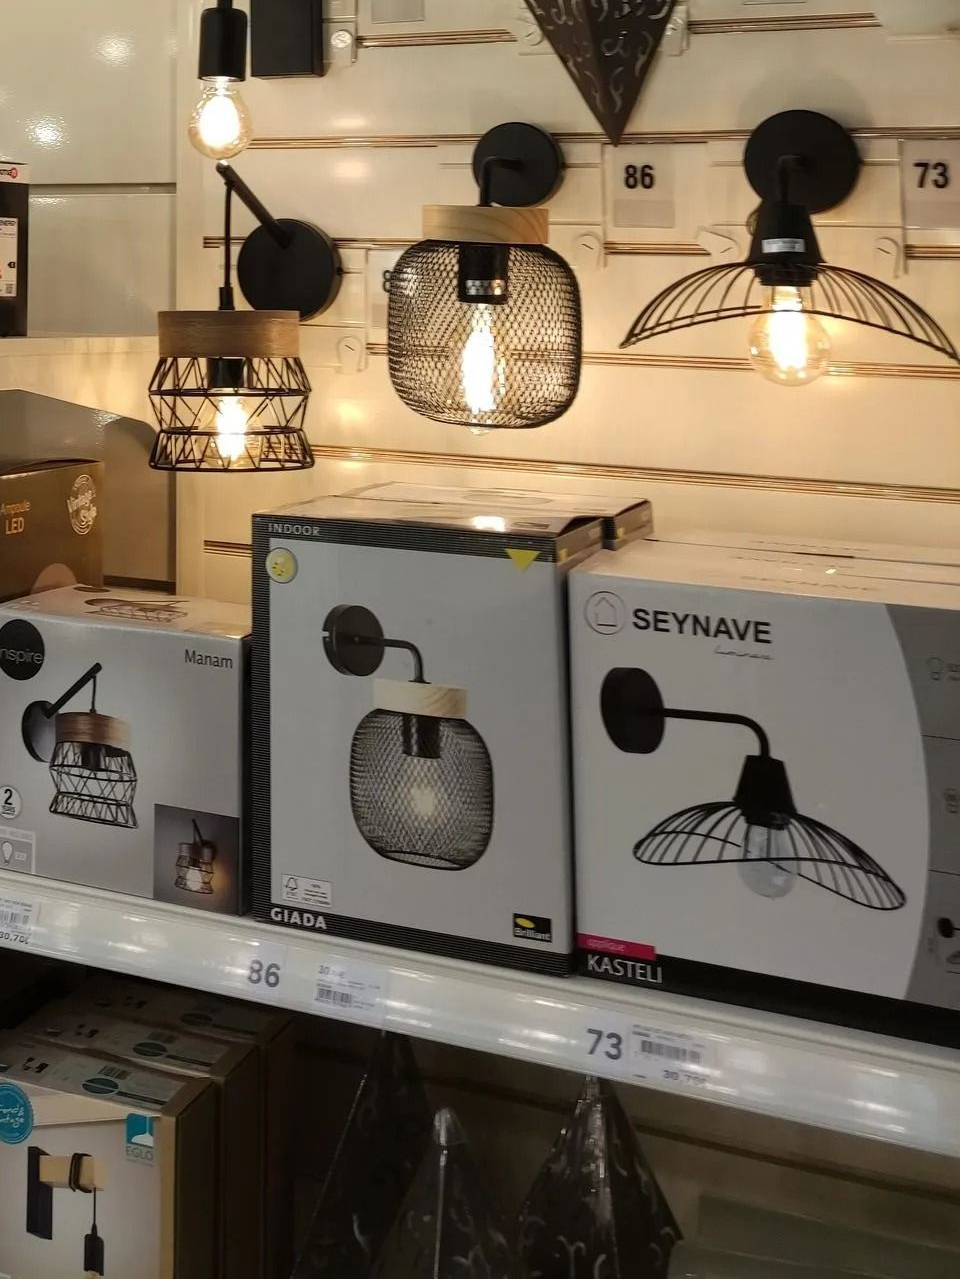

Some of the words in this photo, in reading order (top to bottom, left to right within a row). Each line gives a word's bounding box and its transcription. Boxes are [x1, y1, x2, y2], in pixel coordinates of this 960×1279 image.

[624, 164, 656, 190] 86
[914, 162, 949, 189] 73
[0, 500, 31, 516] Ampoule
[5, 517, 25, 535] LED
[267, 523, 321, 537] INDOOR
[632, 608, 773, 644] SEYNAVE
[184, 649, 234, 669] Manam
[3, 788, 13, 805] 2
[270, 907, 328, 930] GIADA
[514, 926, 552, 942] Brilliant
[247, 958, 281, 988] 86
[587, 954, 663, 984] KASTELI
[587, 1027, 623, 1060] 73
[125, 1146, 154, 1161] EGLO
